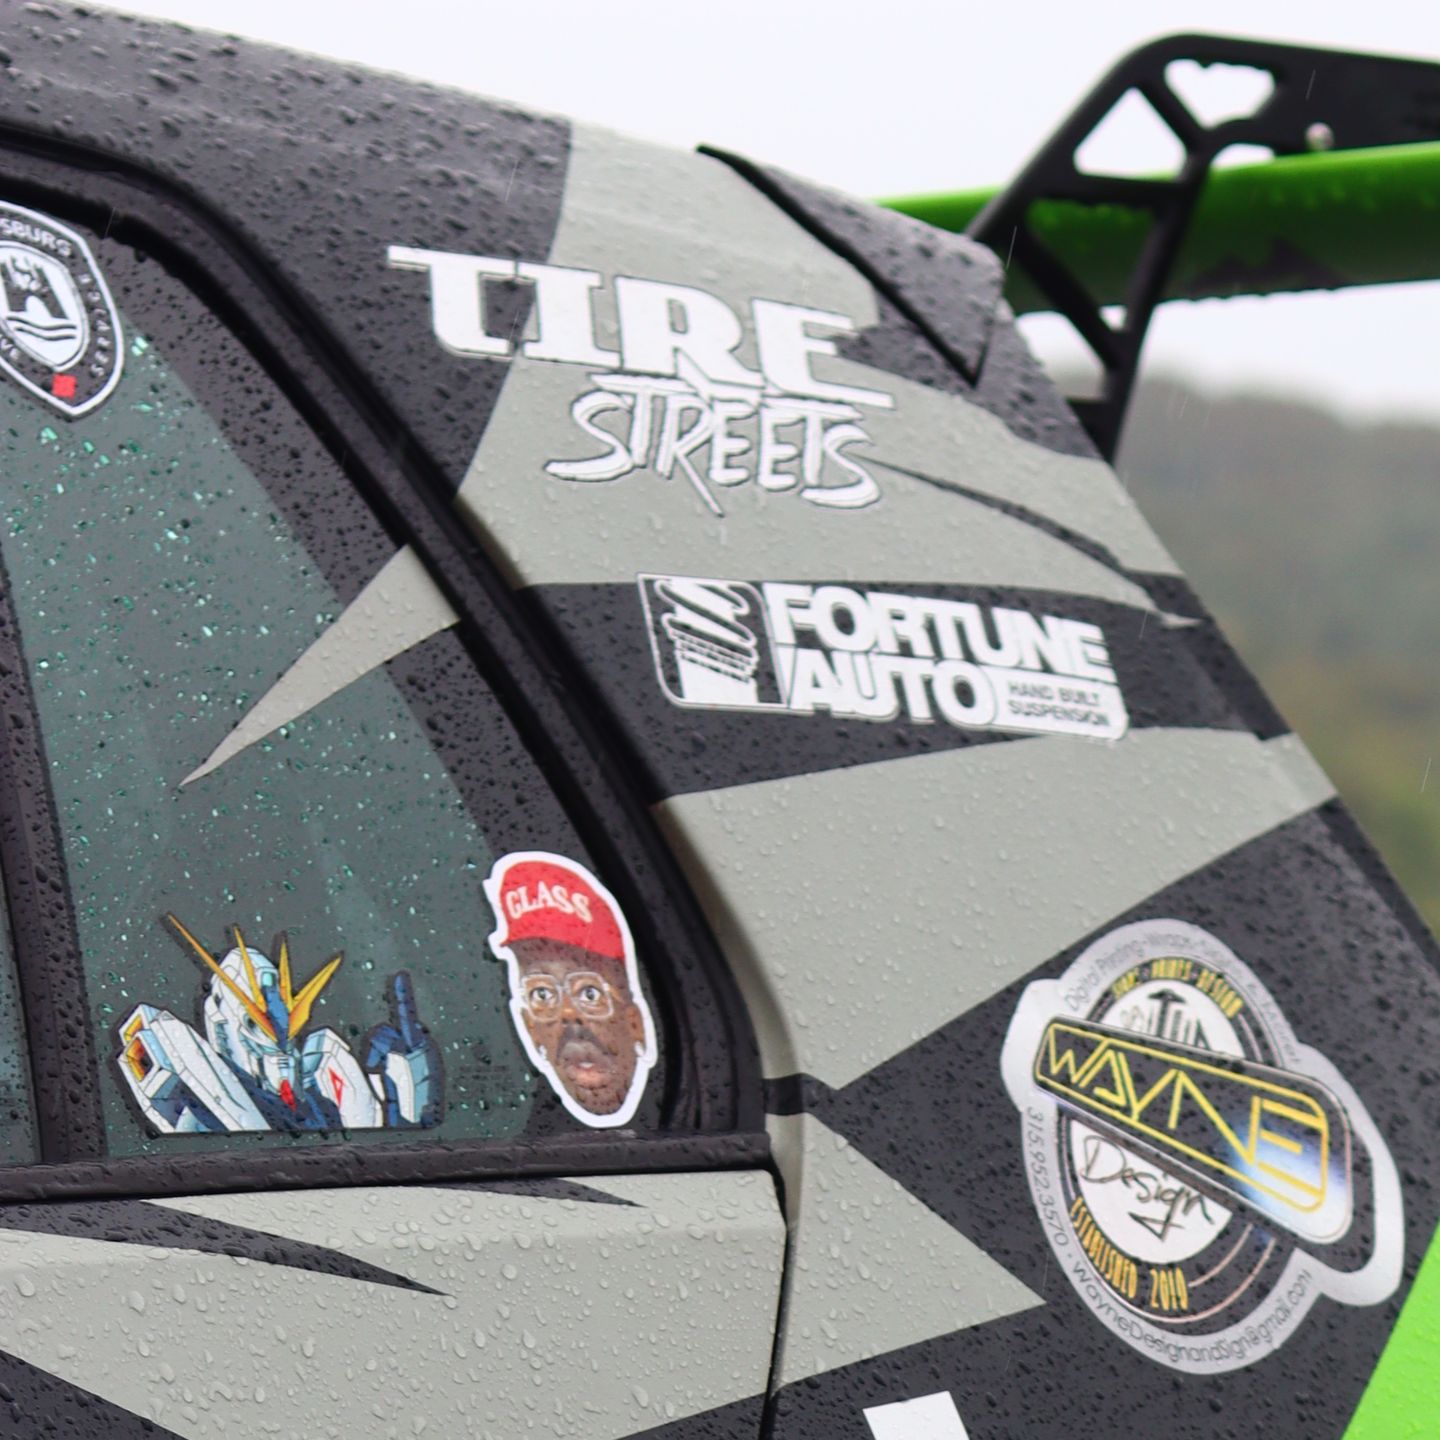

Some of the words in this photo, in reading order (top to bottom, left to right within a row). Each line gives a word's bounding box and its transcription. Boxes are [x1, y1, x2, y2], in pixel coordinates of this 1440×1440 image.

[387, 245, 894, 409] TIRE
[544, 373, 885, 517] STREETS
[762, 581, 1116, 684] FORTUNE
[785, 646, 998, 730] AUTO
[505, 880, 593, 924] CLASS
[1045, 1022, 1329, 1212] WAYNE
[1080, 1133, 1217, 1242] Design
